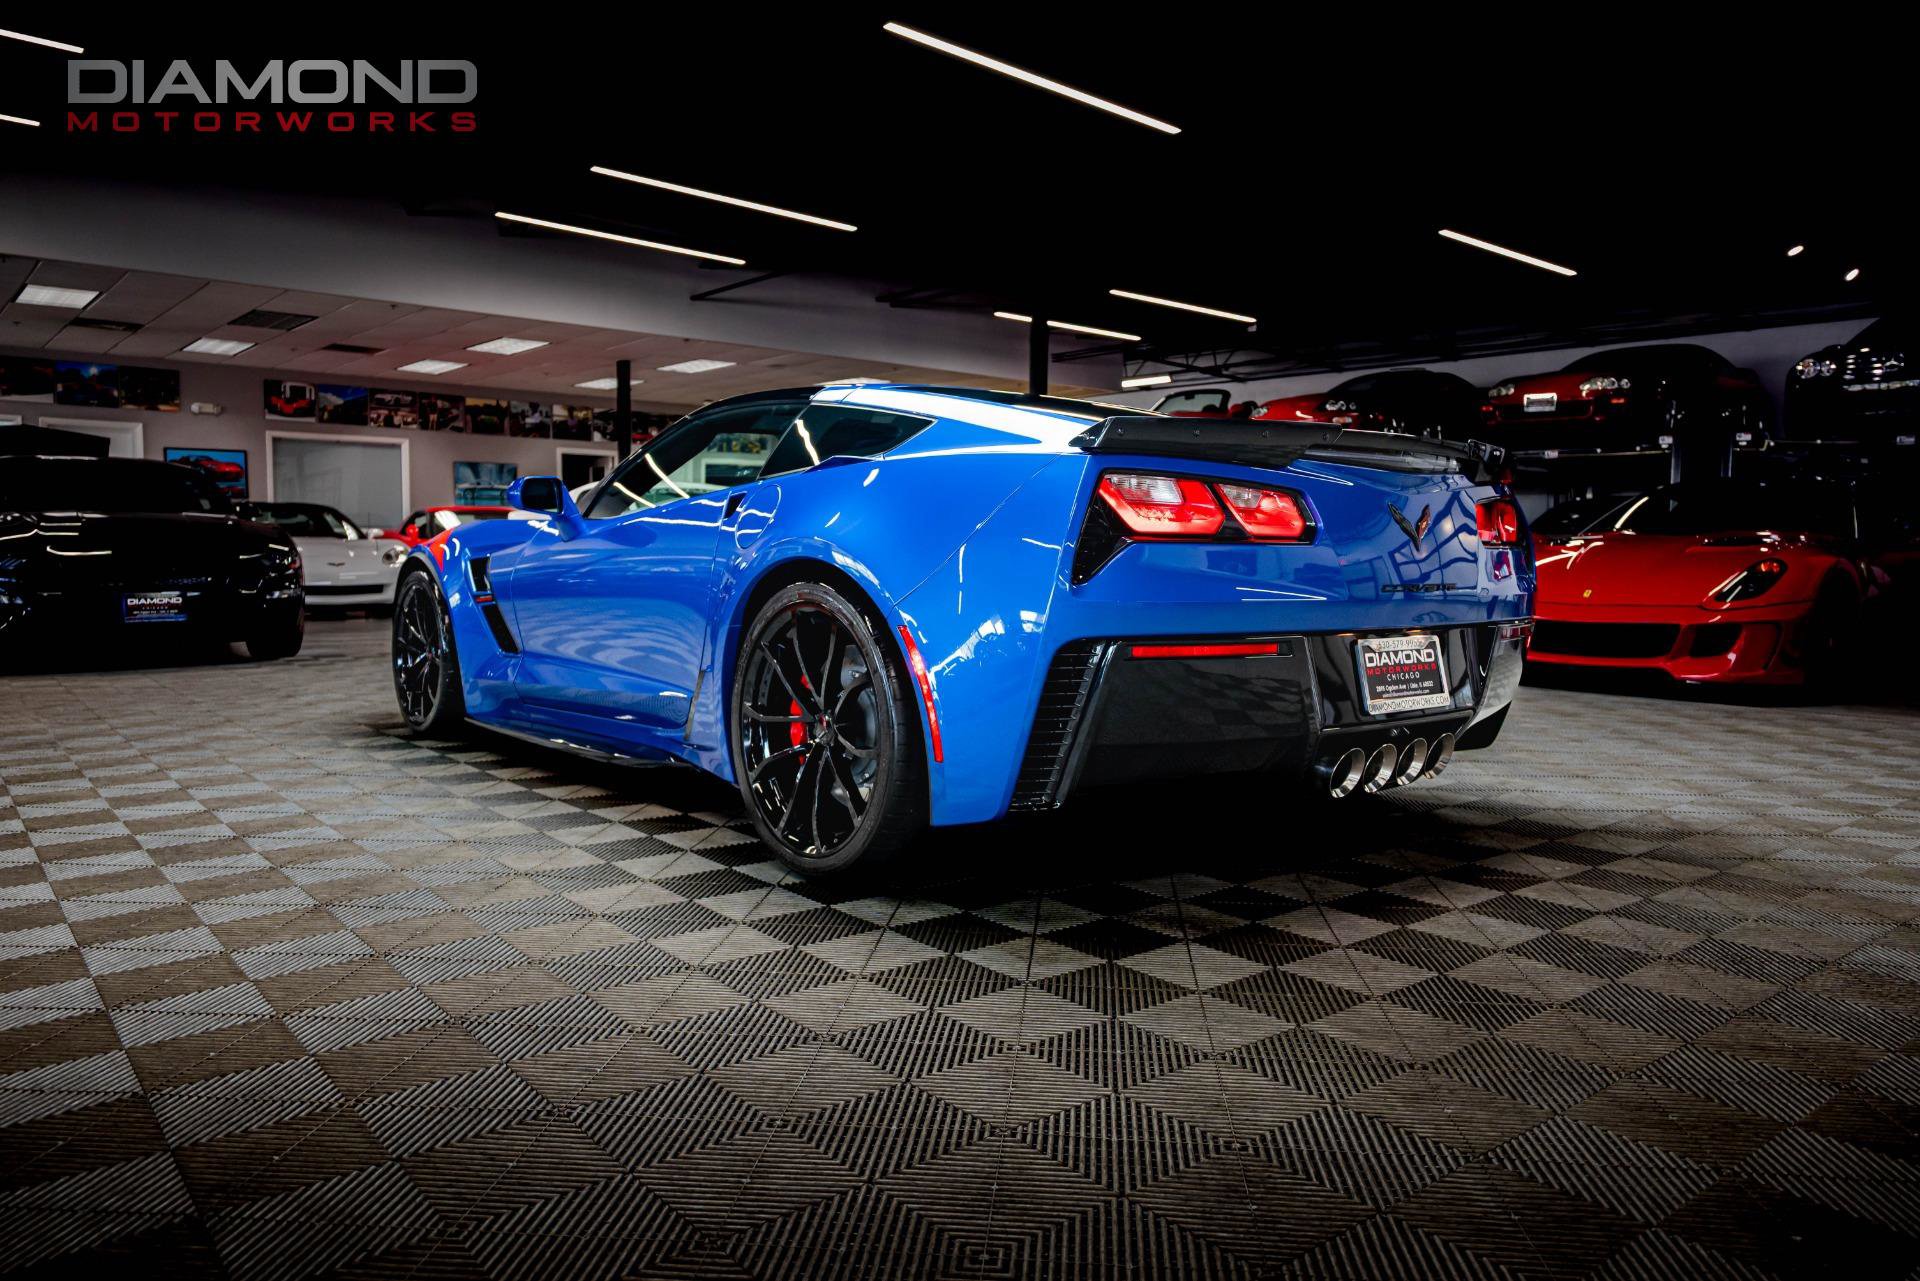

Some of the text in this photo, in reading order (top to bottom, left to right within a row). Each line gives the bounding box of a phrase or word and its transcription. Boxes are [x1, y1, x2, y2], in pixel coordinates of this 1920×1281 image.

[127, 597, 183, 605] DIAMOND
[1365, 649, 1435, 667] DIAMOND
[1367, 662, 1437, 677] MOTORWORKS
[1387, 671, 1421, 682] CHICAGO
